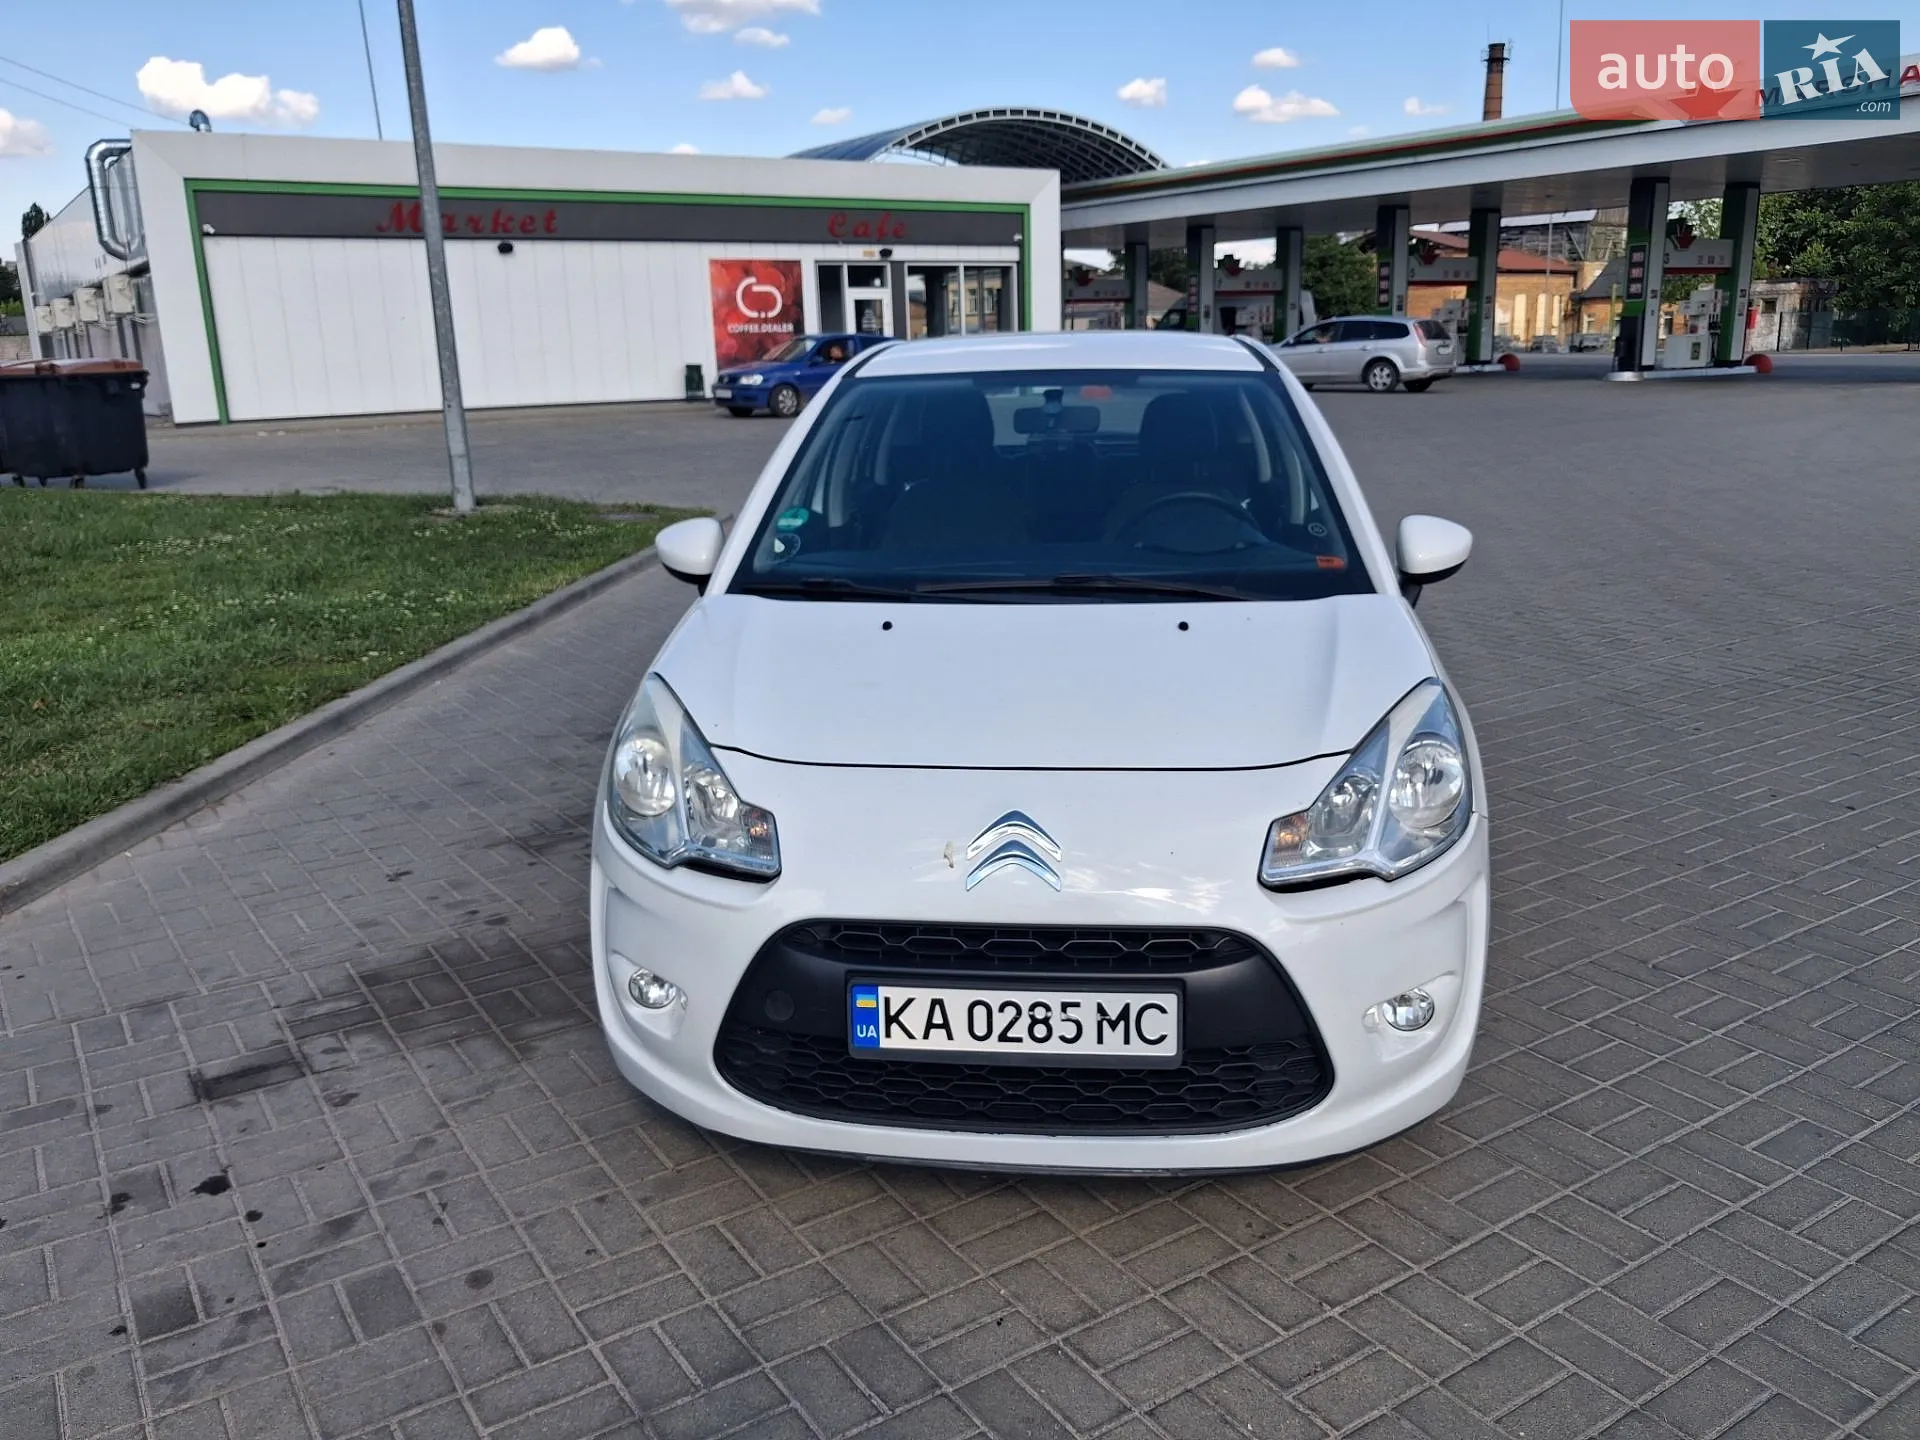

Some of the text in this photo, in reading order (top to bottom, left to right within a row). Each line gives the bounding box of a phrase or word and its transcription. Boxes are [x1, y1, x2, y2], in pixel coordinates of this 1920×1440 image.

[376, 201, 559, 235] Market
[826, 210, 908, 241] Cafe
[857, 1024, 877, 1038] UA
[884, 996, 1169, 1046] KA 0285 MC
